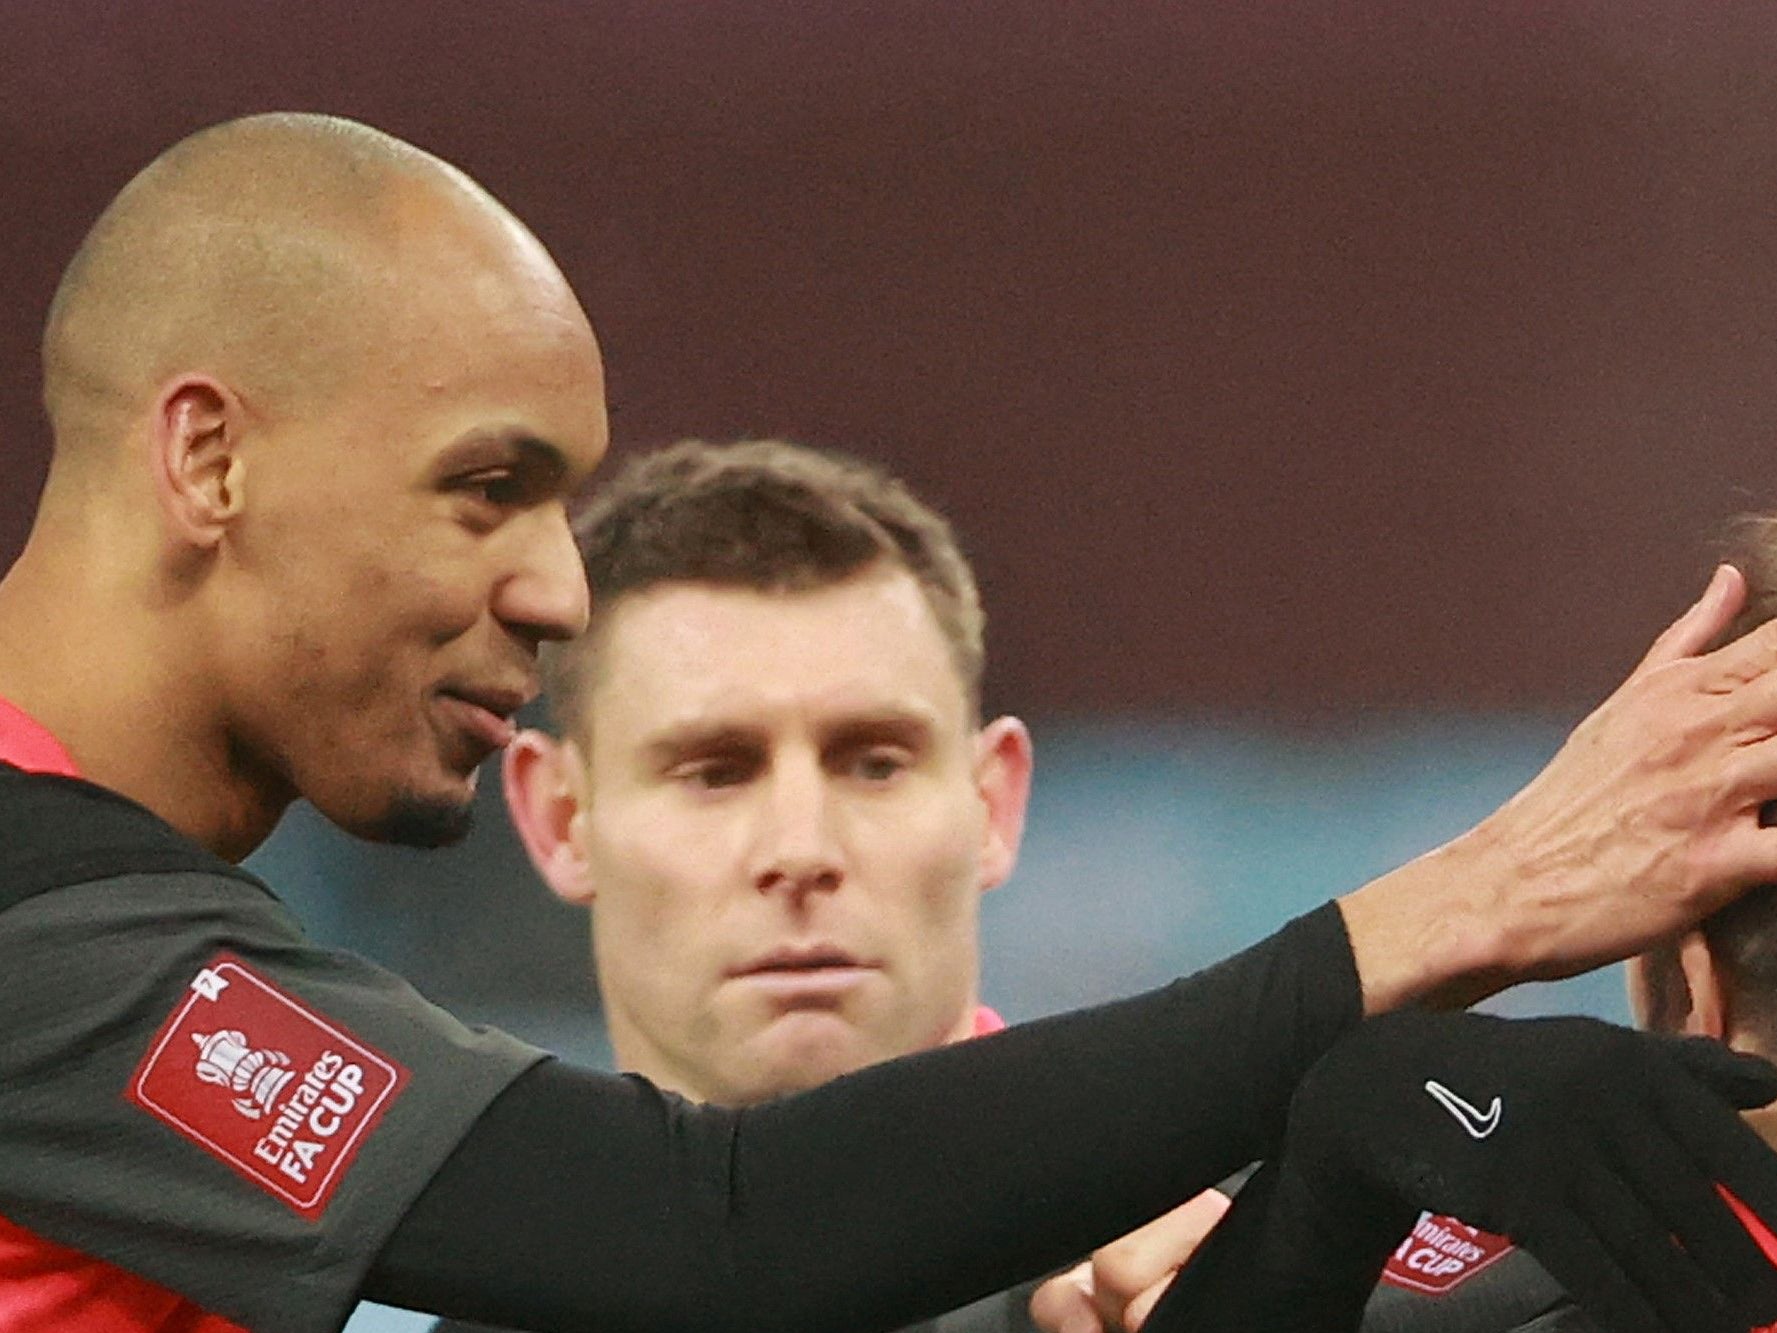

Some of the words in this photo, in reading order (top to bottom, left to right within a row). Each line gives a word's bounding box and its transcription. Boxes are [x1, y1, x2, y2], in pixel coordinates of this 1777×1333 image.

[253, 1050, 343, 1166] Emirates
[280, 1140, 327, 1184] FA
[308, 1063, 364, 1137] CUP
[1407, 1247, 1466, 1277] CUP
[1412, 1219, 1486, 1263] mirates
